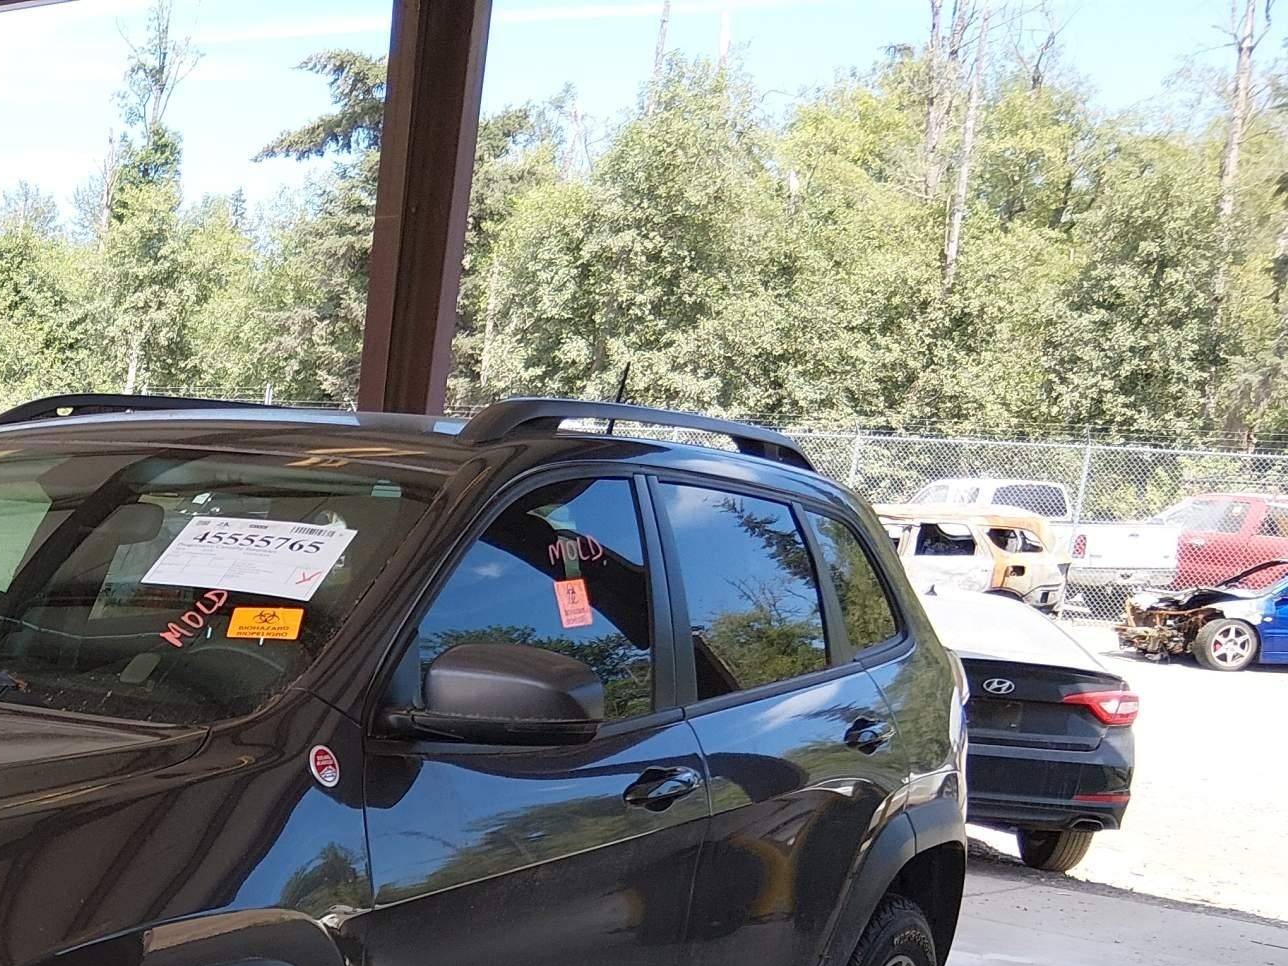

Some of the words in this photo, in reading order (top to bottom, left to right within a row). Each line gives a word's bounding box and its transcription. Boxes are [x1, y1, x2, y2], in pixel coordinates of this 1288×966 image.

[193, 531, 325, 554] 45555765
[548, 534, 603, 565] MOLD
[160, 590, 228, 647] MOLD
